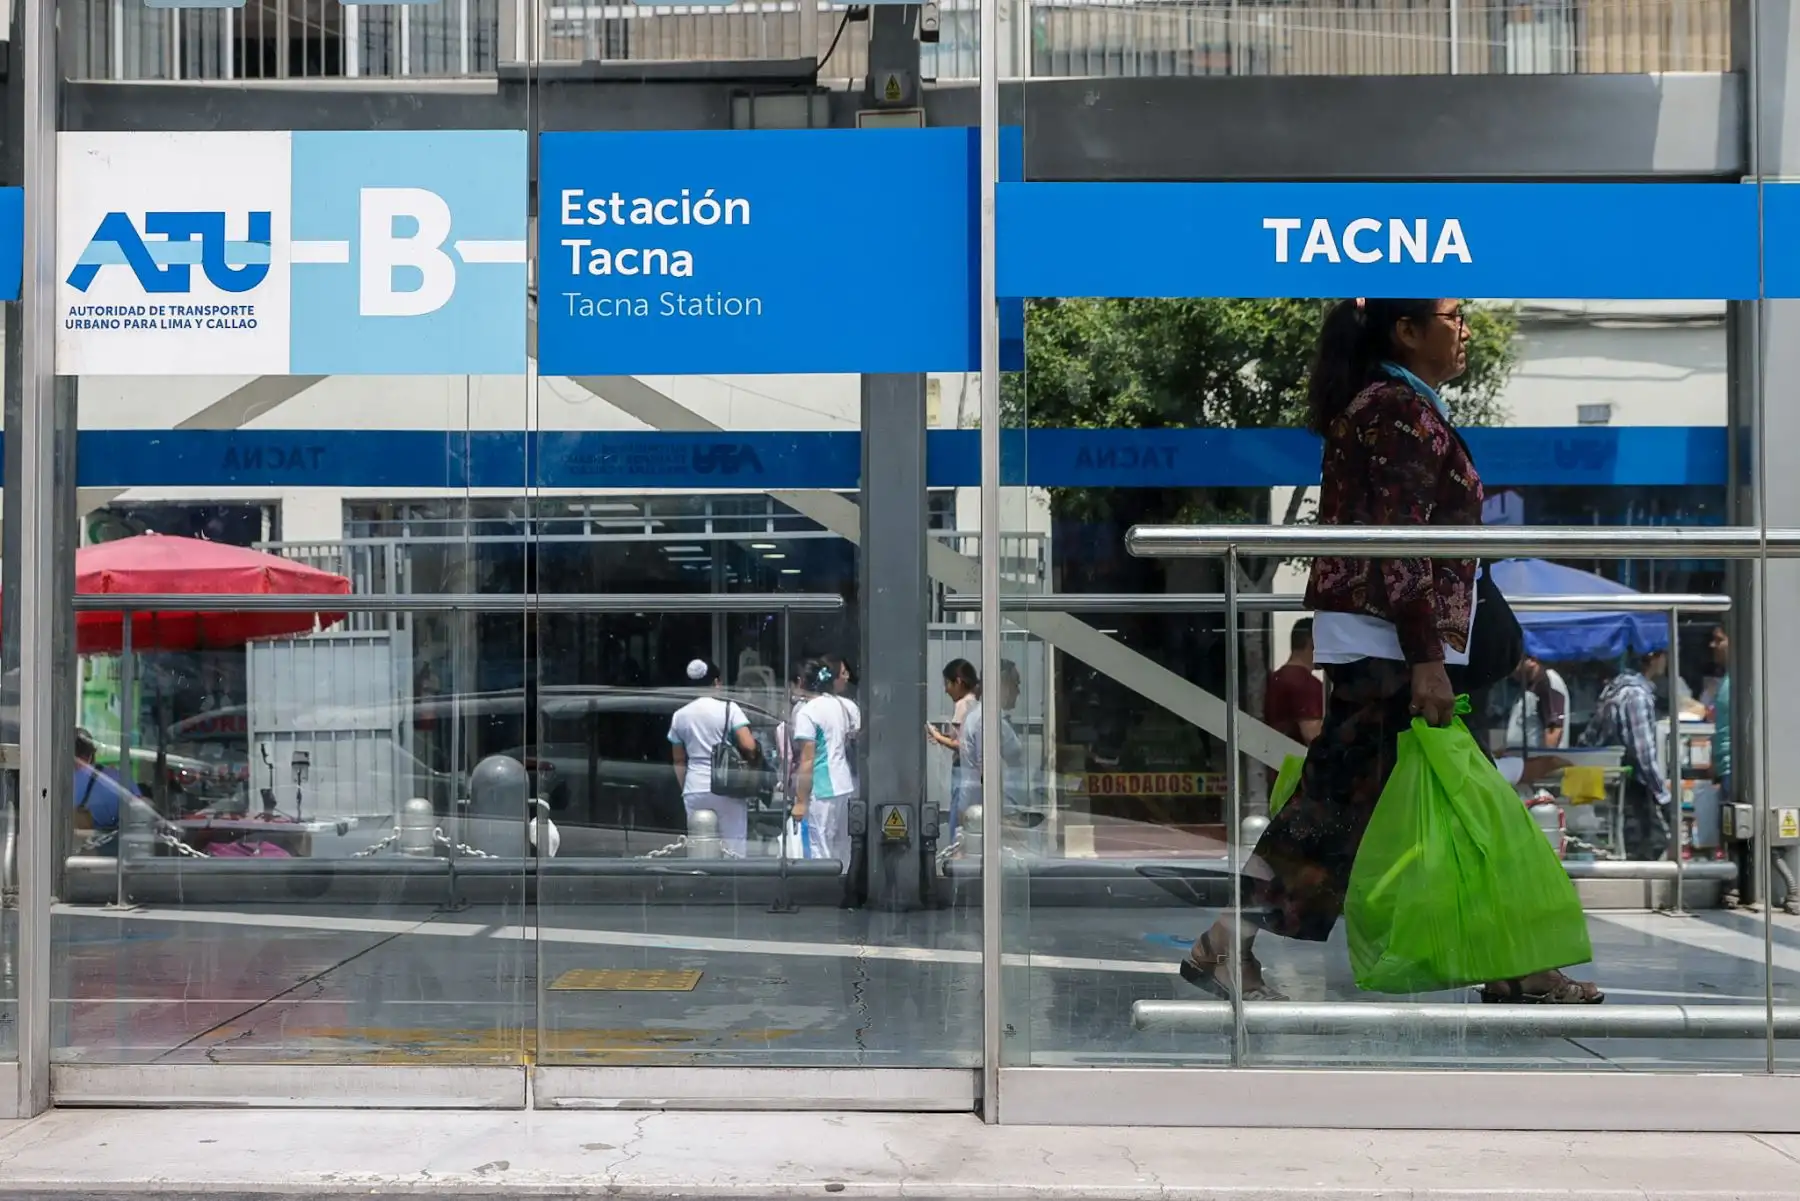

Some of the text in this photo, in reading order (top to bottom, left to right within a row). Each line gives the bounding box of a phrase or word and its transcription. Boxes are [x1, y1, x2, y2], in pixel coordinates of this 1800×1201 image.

[560, 188, 751, 226] Estación
[65, 211, 272, 293] ATU
[360, 187, 456, 316] B
[560, 238, 694, 278] Tacna
[1262, 217, 1473, 264] TACNA
[68, 305, 255, 317] AUTORIDAD DE TRANSPORTE
[561, 291, 762, 317] Tacna Station
[65, 318, 258, 330] URBANO PARA LIMA Y CALLAO
[1088, 774, 1193, 794] BORDADOS
